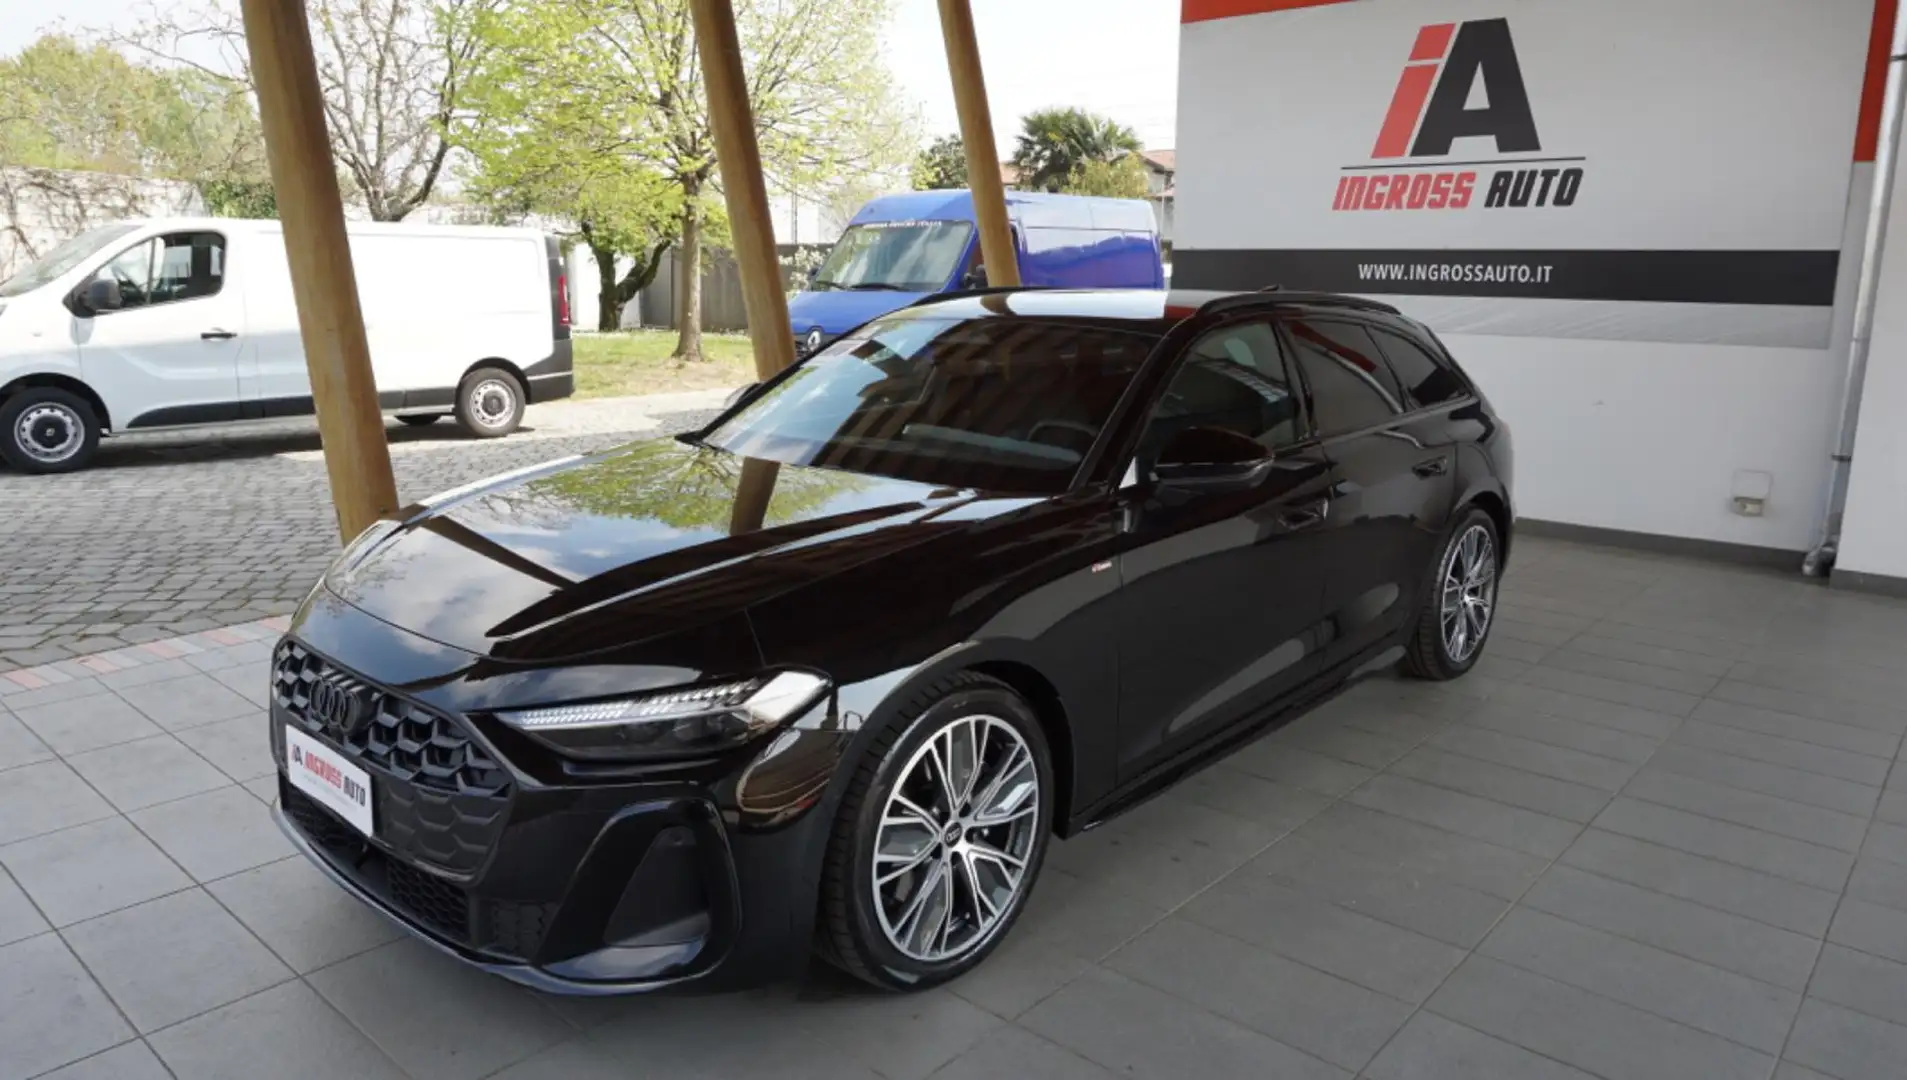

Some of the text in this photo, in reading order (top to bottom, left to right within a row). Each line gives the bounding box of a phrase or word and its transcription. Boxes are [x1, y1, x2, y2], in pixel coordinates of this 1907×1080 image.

[1331, 167, 1584, 211] INGROSS AUTO
[1358, 263, 1554, 283] WWW.INGROSSAUTO.IT
[344, 775, 366, 807] AUTO
